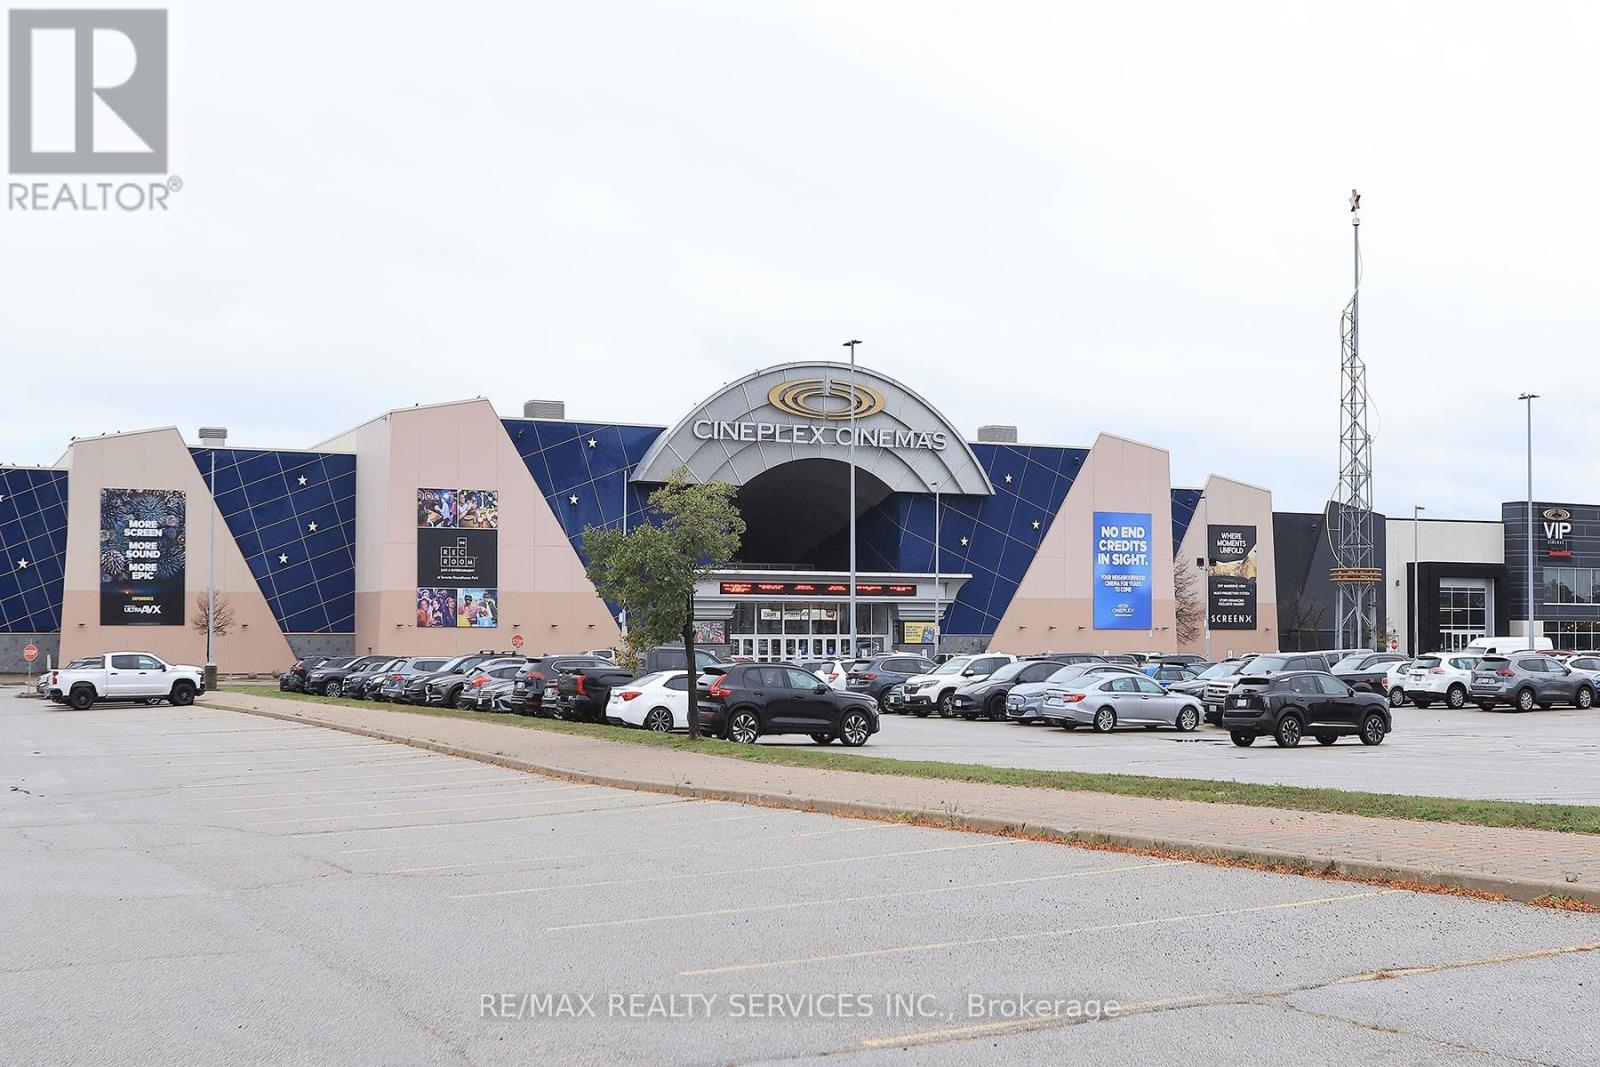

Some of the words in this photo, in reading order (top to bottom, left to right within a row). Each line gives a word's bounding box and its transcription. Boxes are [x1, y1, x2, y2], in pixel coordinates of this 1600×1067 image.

[693, 419, 826, 445] CINEPLEX
[835, 427, 948, 451] CINEMAS
[129, 520, 158, 528] MORE
[124, 528, 162, 537] SCREEN
[1101, 526, 1119, 539] NO
[1121, 527, 1145, 539] END
[1543, 521, 1572, 539] VIP
[1221, 532, 1242, 540] WHERE
[129, 542, 158, 550] MORE
[1099, 539, 1148, 553] CREDITS
[1217, 539, 1246, 548] MOMENTS
[126, 549, 160, 559] SOUND
[1219, 546, 1244, 555] UNFOLD
[1098, 553, 1110, 566] IN
[1112, 553, 1149, 566] SIGHT.
[132, 571, 154, 580] EPIC
[1211, 614, 1252, 623] SCREENX
